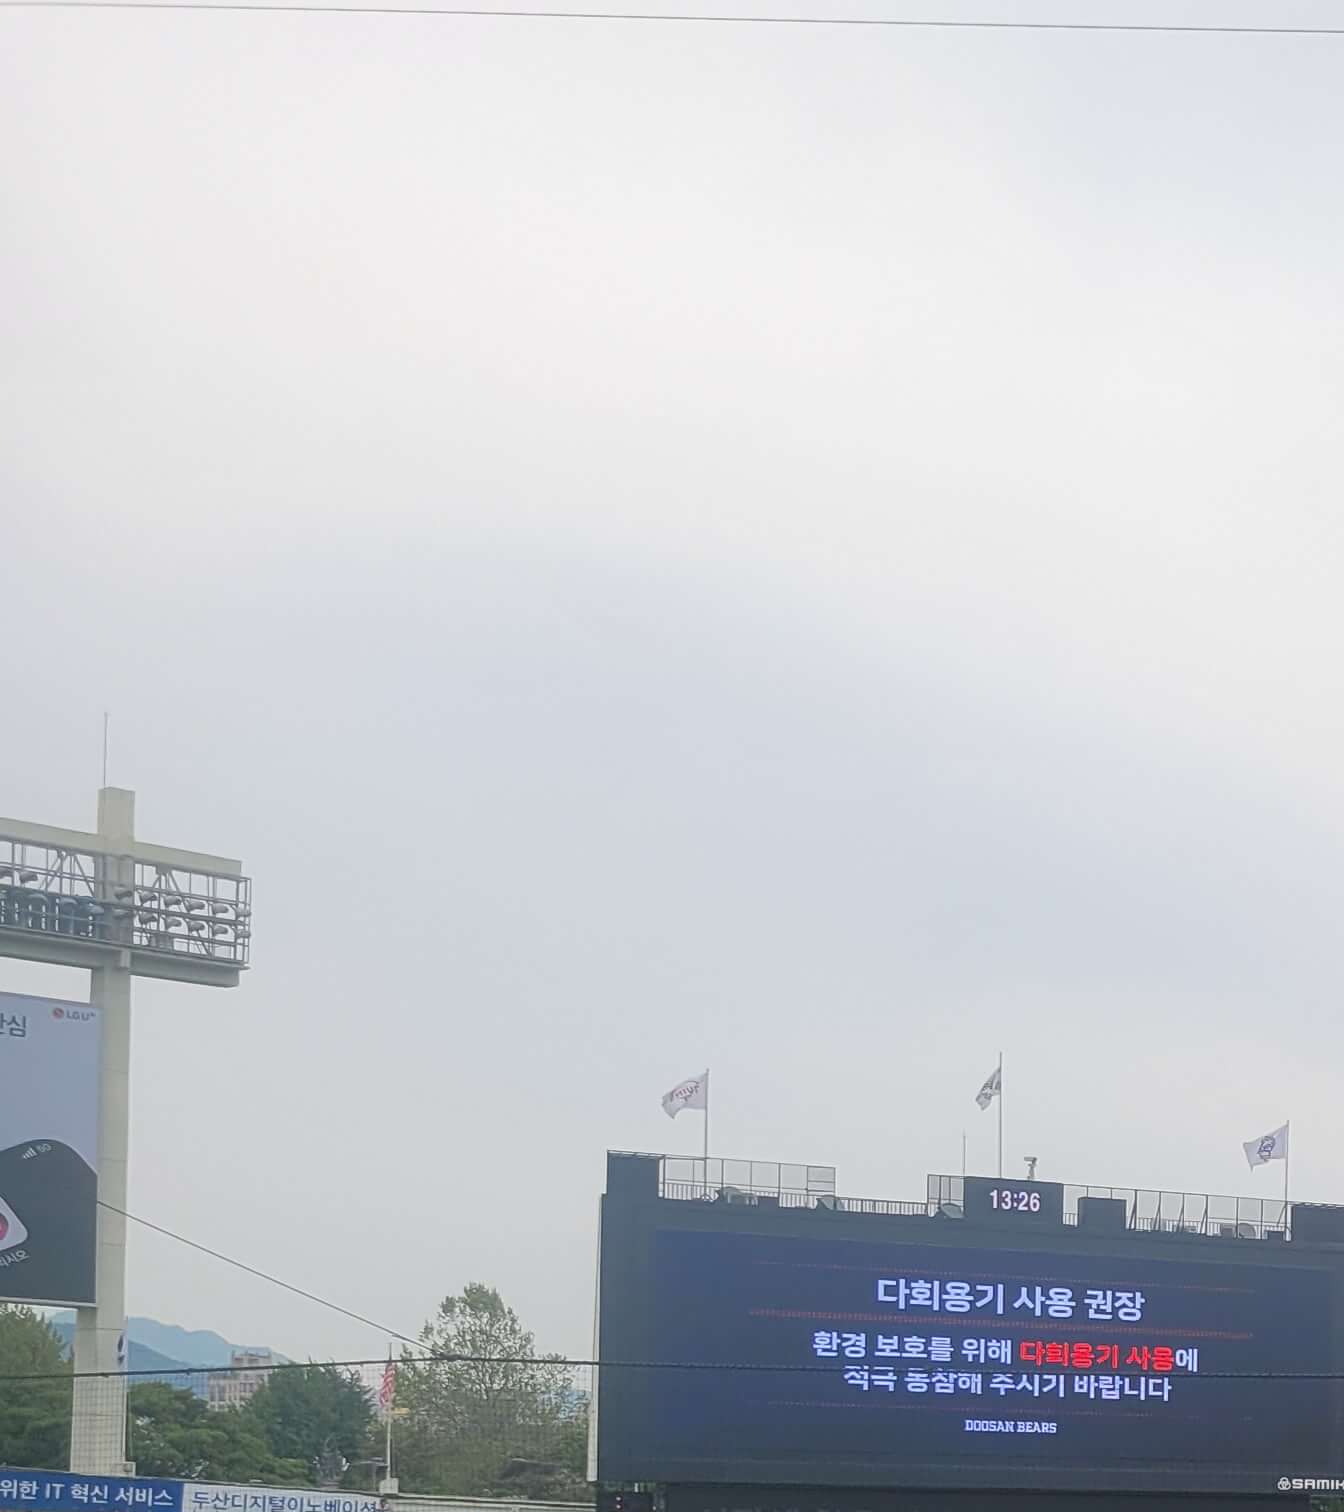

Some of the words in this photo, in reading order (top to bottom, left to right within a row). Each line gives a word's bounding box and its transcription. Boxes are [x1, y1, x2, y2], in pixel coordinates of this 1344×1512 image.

[989, 1188, 1041, 1214] 13:26
[877, 1278, 1004, 1314] 다회용기
[1013, 1286, 1076, 1318] 사용
[1083, 1289, 1145, 1322] 권장
[812, 1330, 867, 1359] 환경
[874, 1334, 954, 1363] 보호를
[961, 1337, 1012, 1365] 위해
[1018, 1340, 1119, 1369] 다회용기
[1126, 1345, 1199, 1373] 사용에
[842, 1365, 898, 1392] 적극
[903, 1367, 982, 1395] 동참해
[989, 1372, 1065, 1398] 주시기
[1073, 1373, 1172, 1402] 바랍니다
[964, 1419, 1014, 1433] DOOSAN
[1016, 1420, 1058, 1435] BEARS
[0, 1479, 40, 1501] 위한
[45, 1483, 65, 1500] IT
[70, 1482, 110, 1505] 혁신
[115, 1485, 175, 1508] 서비스
